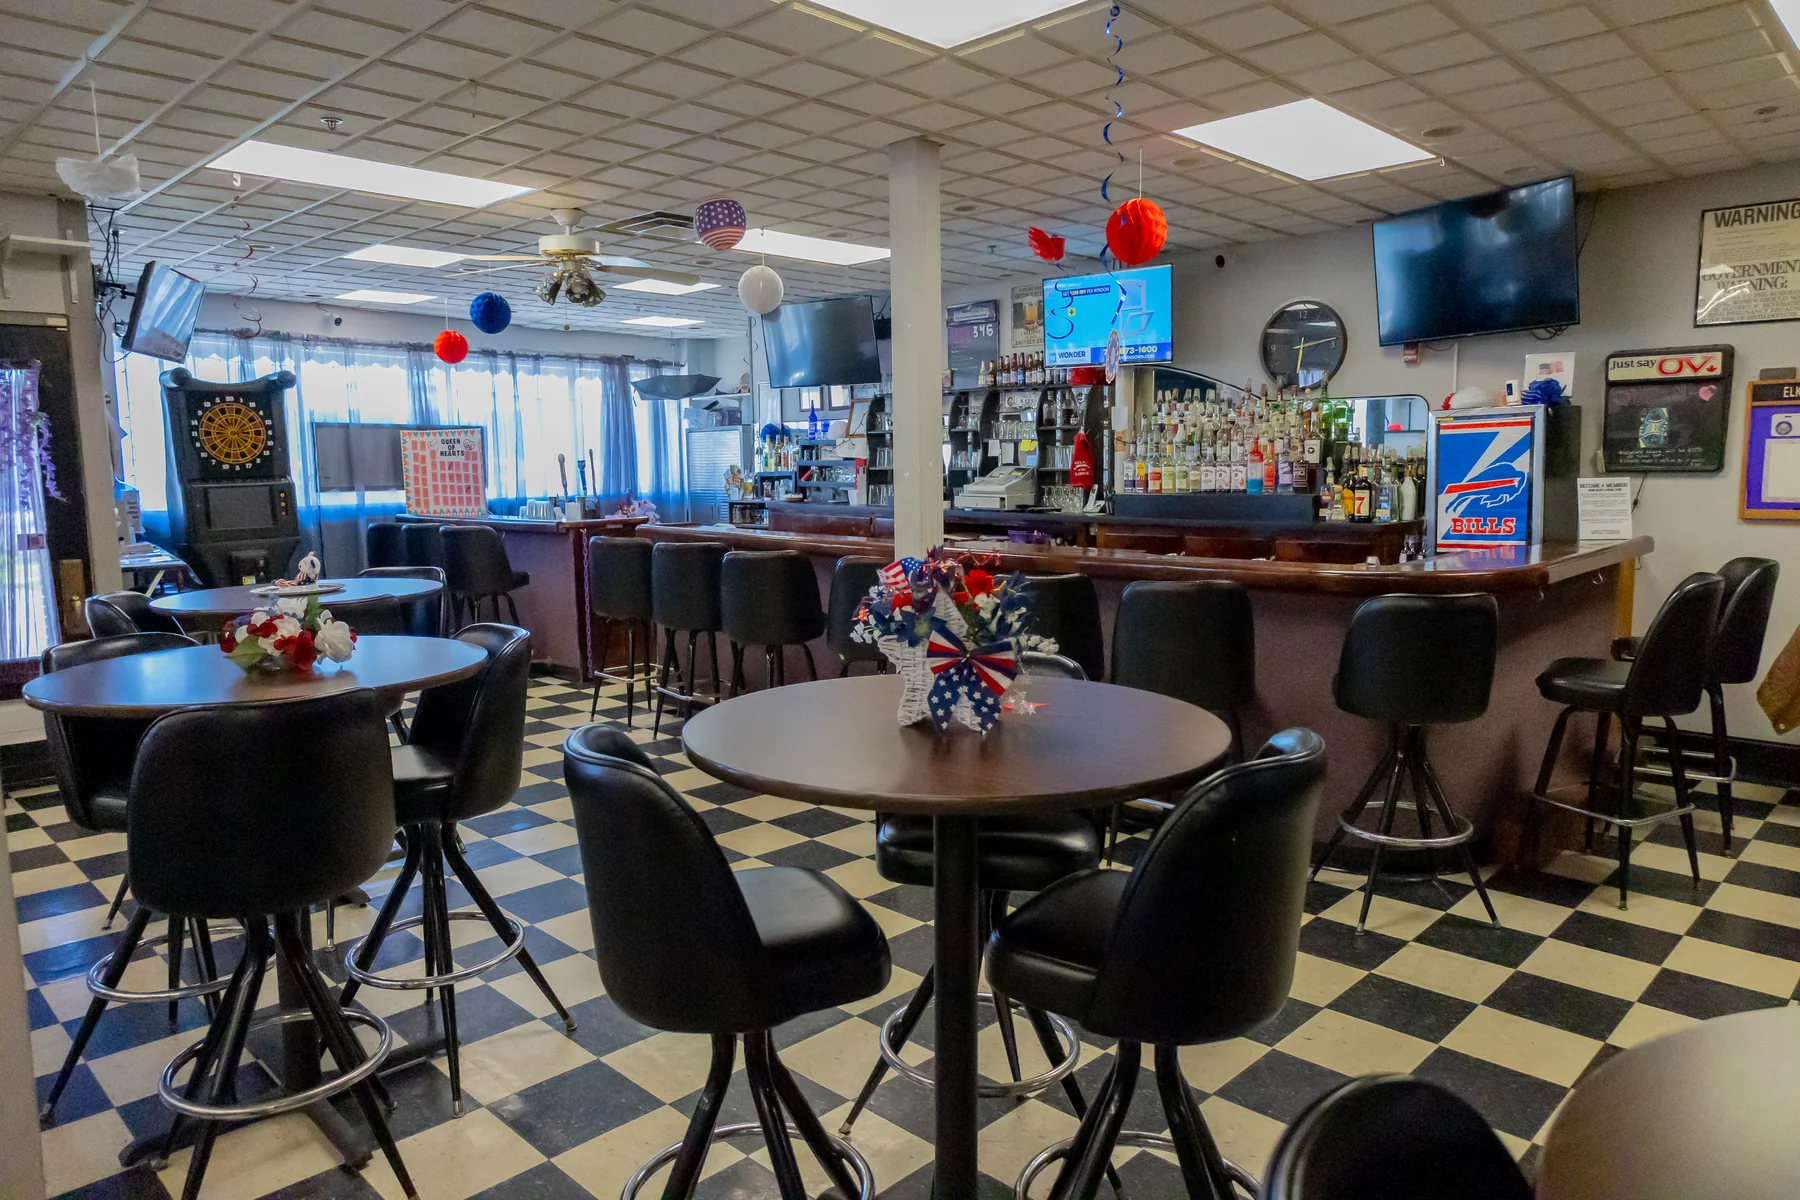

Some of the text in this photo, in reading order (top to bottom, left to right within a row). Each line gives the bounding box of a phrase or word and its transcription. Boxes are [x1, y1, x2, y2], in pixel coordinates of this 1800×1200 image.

[1714, 202, 1800, 228] WARNING
[1299, 311, 1308, 319] 12
[972, 323, 994, 338] 346
[1058, 350, 1086, 359] WONDER
[1610, 355, 1716, 376] Just say OV
[1355, 496, 1366, 515] 7
[1450, 517, 1516, 535] BILLS
